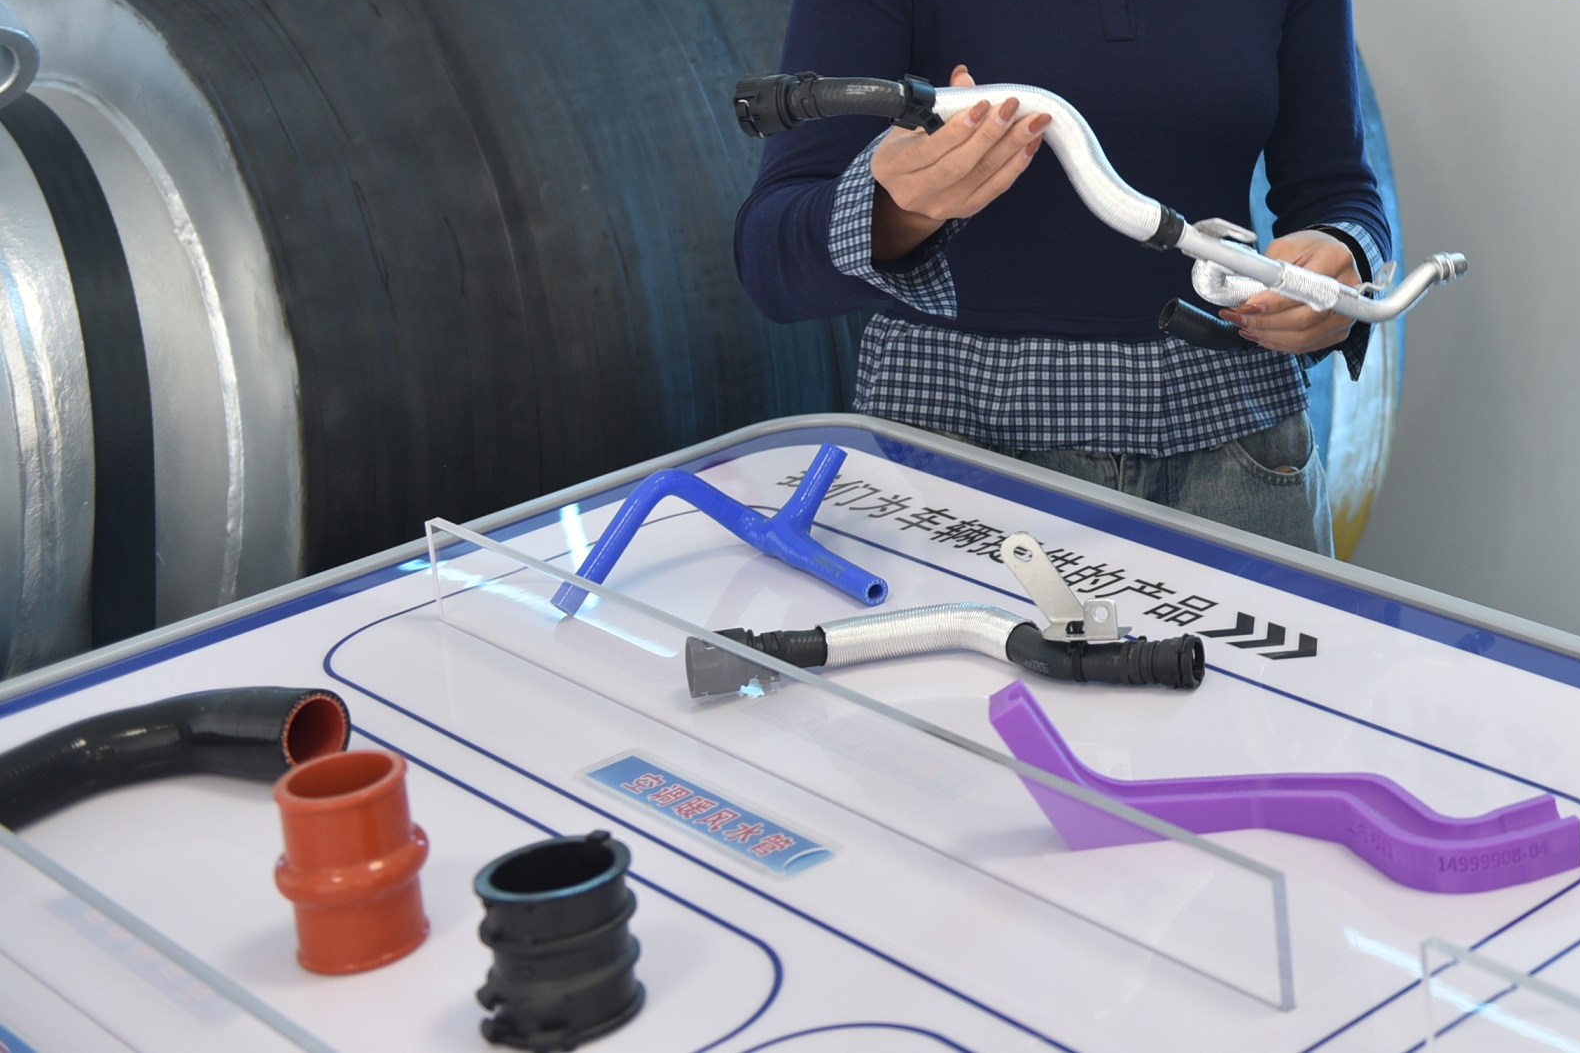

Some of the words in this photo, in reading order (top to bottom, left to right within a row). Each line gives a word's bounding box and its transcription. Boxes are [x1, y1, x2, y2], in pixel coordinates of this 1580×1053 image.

[621, 771, 797, 859] 空调暖风水管
